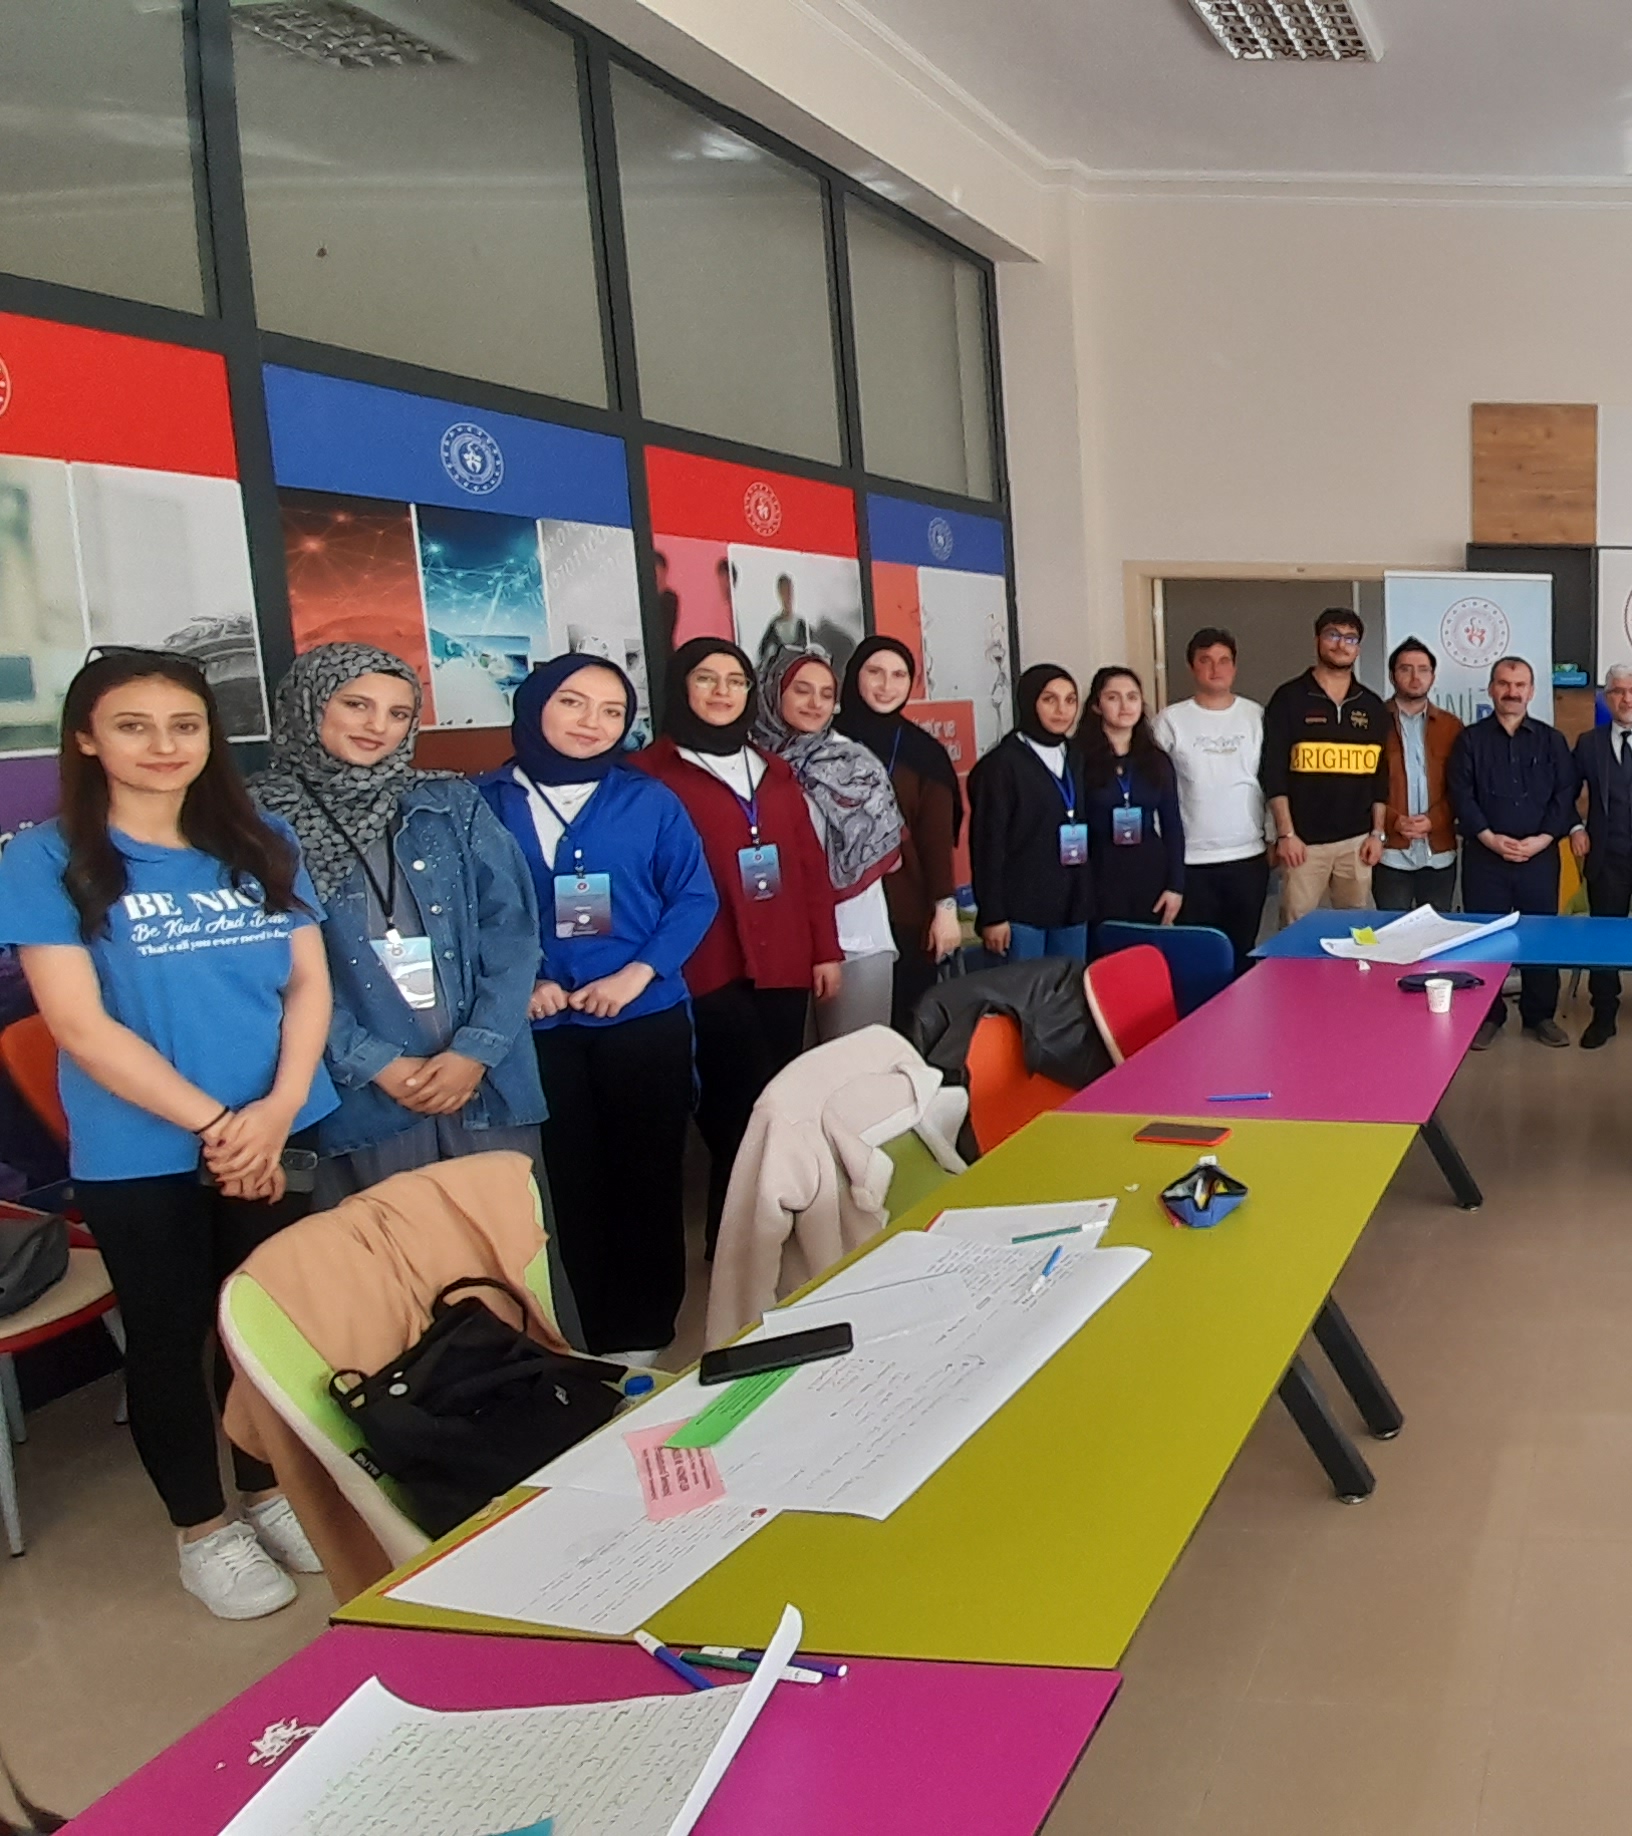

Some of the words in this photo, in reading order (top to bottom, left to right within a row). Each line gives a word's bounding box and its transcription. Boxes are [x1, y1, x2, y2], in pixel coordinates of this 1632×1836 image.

[123, 892, 183, 920] BE
[131, 923, 161, 942] Be
[163, 917, 202, 939] Kind
[205, 912, 246, 933] And
